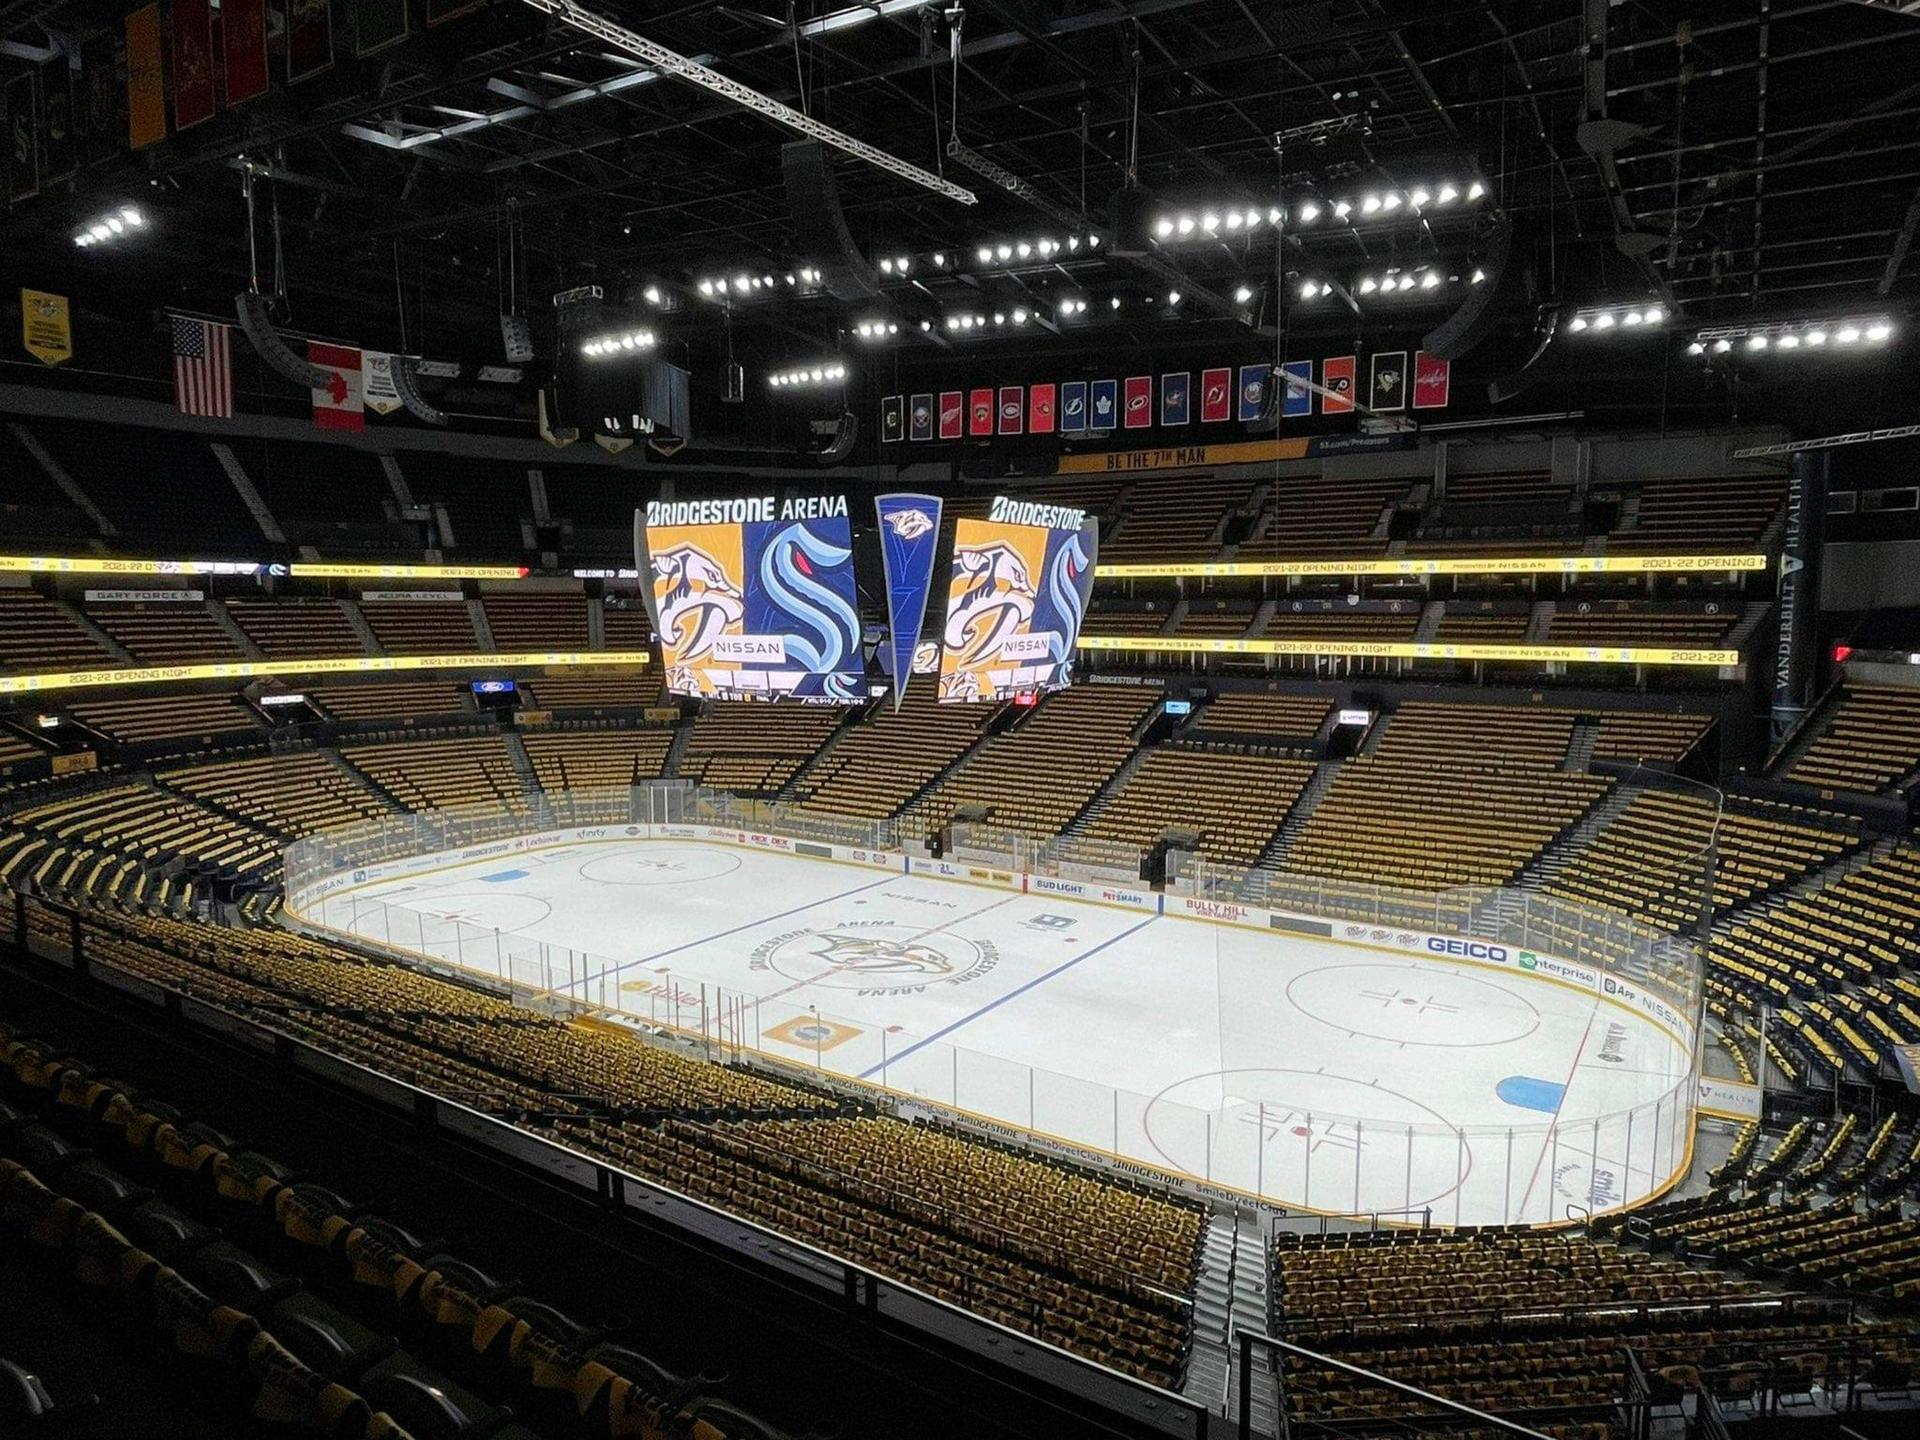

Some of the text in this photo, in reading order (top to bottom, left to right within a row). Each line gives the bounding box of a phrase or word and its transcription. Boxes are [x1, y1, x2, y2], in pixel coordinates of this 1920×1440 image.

[1107, 454, 1122, 469] BE
[1127, 452, 1150, 468] THE
[1176, 448, 1206, 466] MAN
[646, 495, 848, 527] BRIDGESTONE ARENA
[989, 497, 1084, 530] BRIDGESTONE
[1302, 564, 1344, 572] OPENING
[1345, 563, 1377, 572] NIGHT
[1642, 558, 1694, 568] 2021-22
[1697, 557, 1757, 568] OPENING
[1776, 582, 1796, 689] VANDERBILT
[1786, 478, 1802, 548] HEALTH
[97, 591, 179, 600] GARY FORCE
[714, 641, 781, 656] NISSAN
[1004, 639, 1048, 652] NISSAN
[1274, 644, 1393, 654] 2021-22 OPENING NIGHT
[458, 656, 499, 664] OPENING
[500, 656, 528, 664] NIGHT
[1520, 649, 1570, 657] NISSAN
[1671, 652, 1725, 661] 2021-22
[69, 667, 193, 684] 2021-22 OPENING NIGHT
[1089, 674, 1142, 685] BRIDGESTONE
[306, 878, 344, 897] NISSAN
[1036, 879, 1083, 893] BUD LIGHT
[1102, 891, 1142, 904] PETSMART
[1186, 899, 1248, 917] BULLY HILL
[836, 919, 896, 929] ARENA
[1427, 936, 1508, 963] GEICO
[857, 985, 927, 997] ARENA
[1642, 996, 1687, 1034] NISSAN
[1714, 1091, 1754, 1103] HEALTH
[957, 1112, 1018, 1138] BRIDGESTONE
[1026, 1133, 1103, 1164] SmileDirectClub
[1112, 1159, 1185, 1189] BRIDGESTONE
